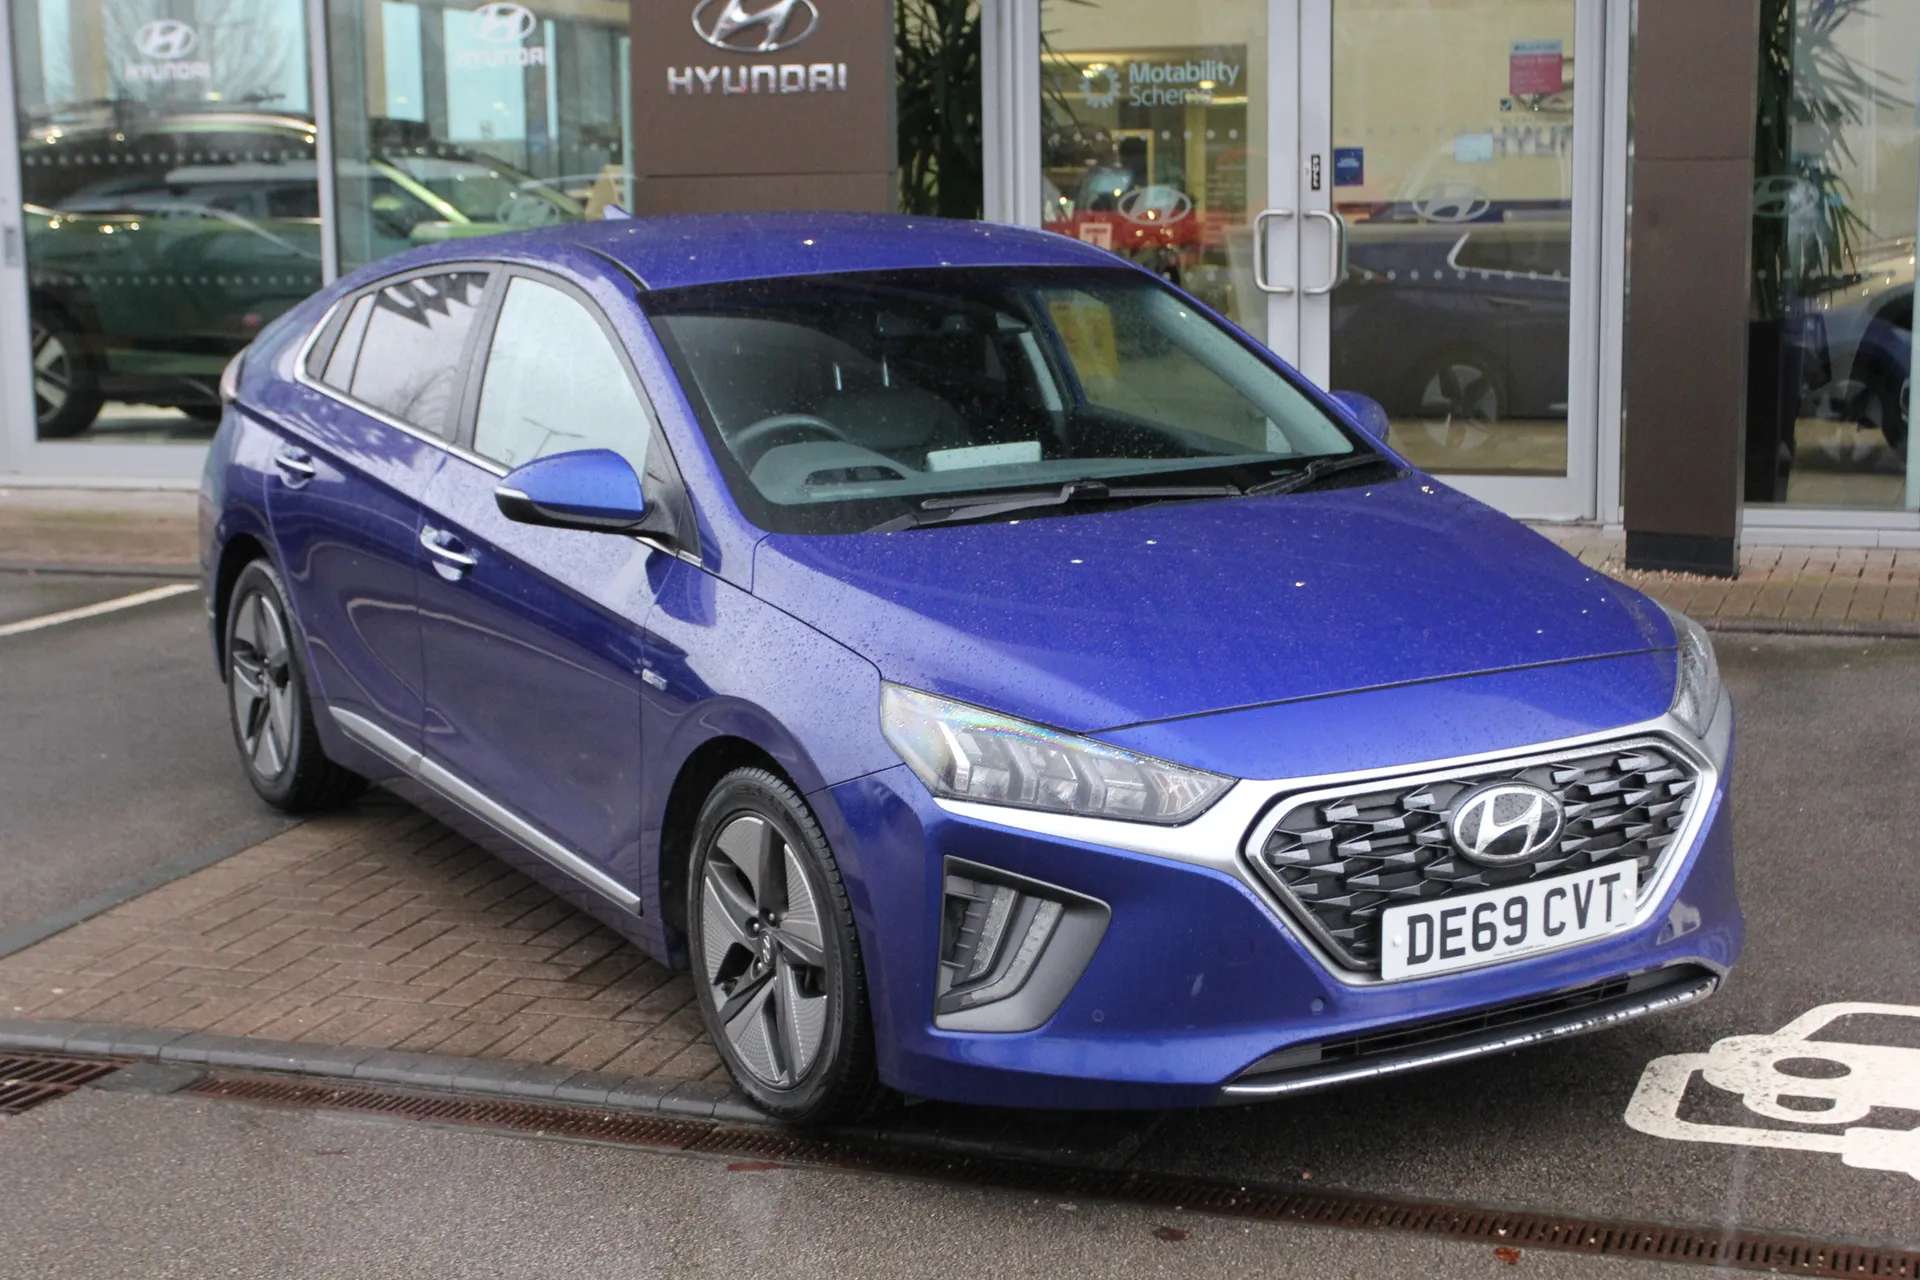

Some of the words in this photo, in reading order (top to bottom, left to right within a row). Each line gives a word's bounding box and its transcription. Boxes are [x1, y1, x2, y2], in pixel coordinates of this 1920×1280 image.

[667, 63, 848, 95] HYUNDAI
[1129, 60, 1240, 87] Motability
[1406, 895, 1528, 966] DE69
[1543, 873, 1621, 937] CVT
